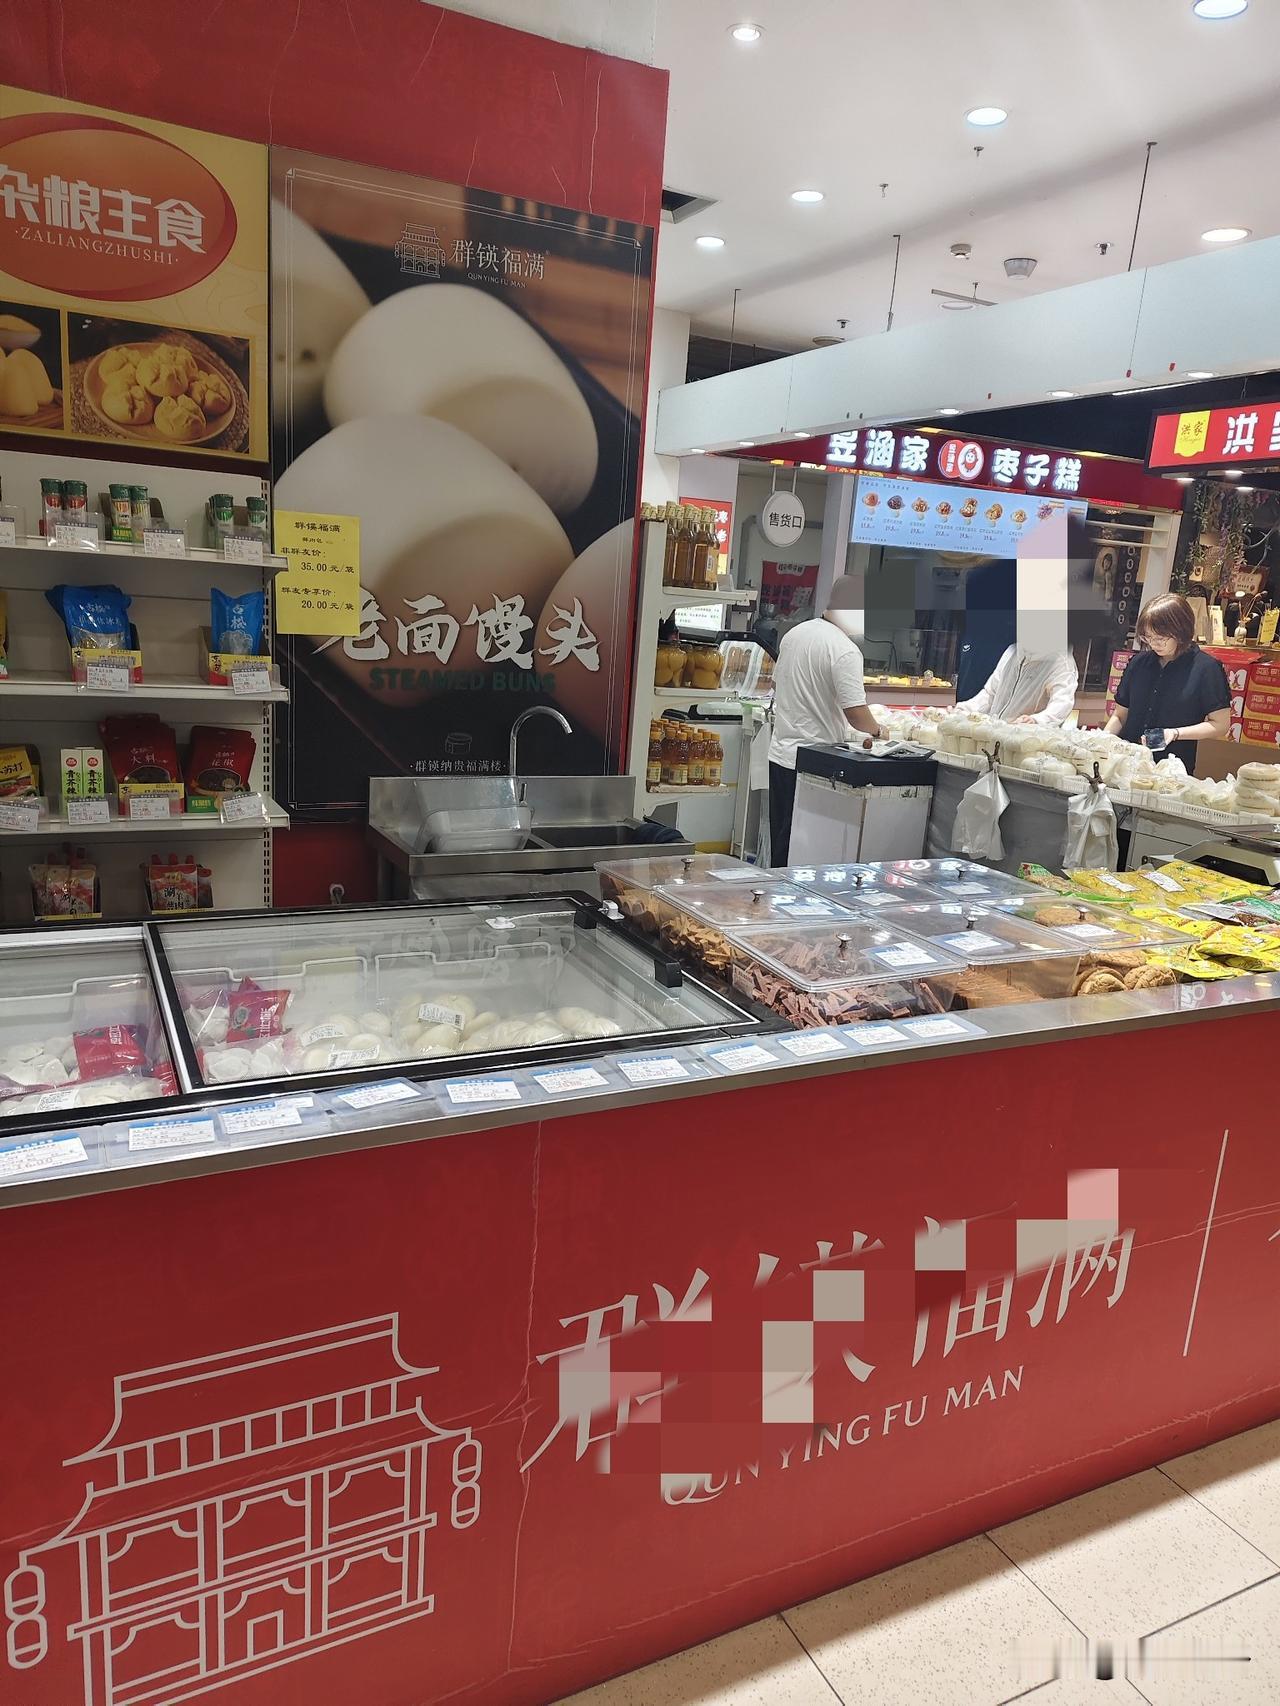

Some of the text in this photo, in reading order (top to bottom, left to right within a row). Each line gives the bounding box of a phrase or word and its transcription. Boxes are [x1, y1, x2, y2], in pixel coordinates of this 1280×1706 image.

[0, 163, 207, 255] 杂粮主食
[449, 239, 545, 281] 群锳福满
[467, 272, 483, 281] QUN
[500, 277, 509, 286] FU
[510, 279, 526, 289] MAN
[991, 447, 1083, 492] 枣子糕
[769, 512, 803, 529] 售货口
[301, 562, 327, 572] 35.00
[301, 600, 327, 609] 20.00
[369, 667, 556, 693] STEAMED BUNS
[881, 1394, 929, 1438] FU
[943, 1365, 1026, 1420] MAN
